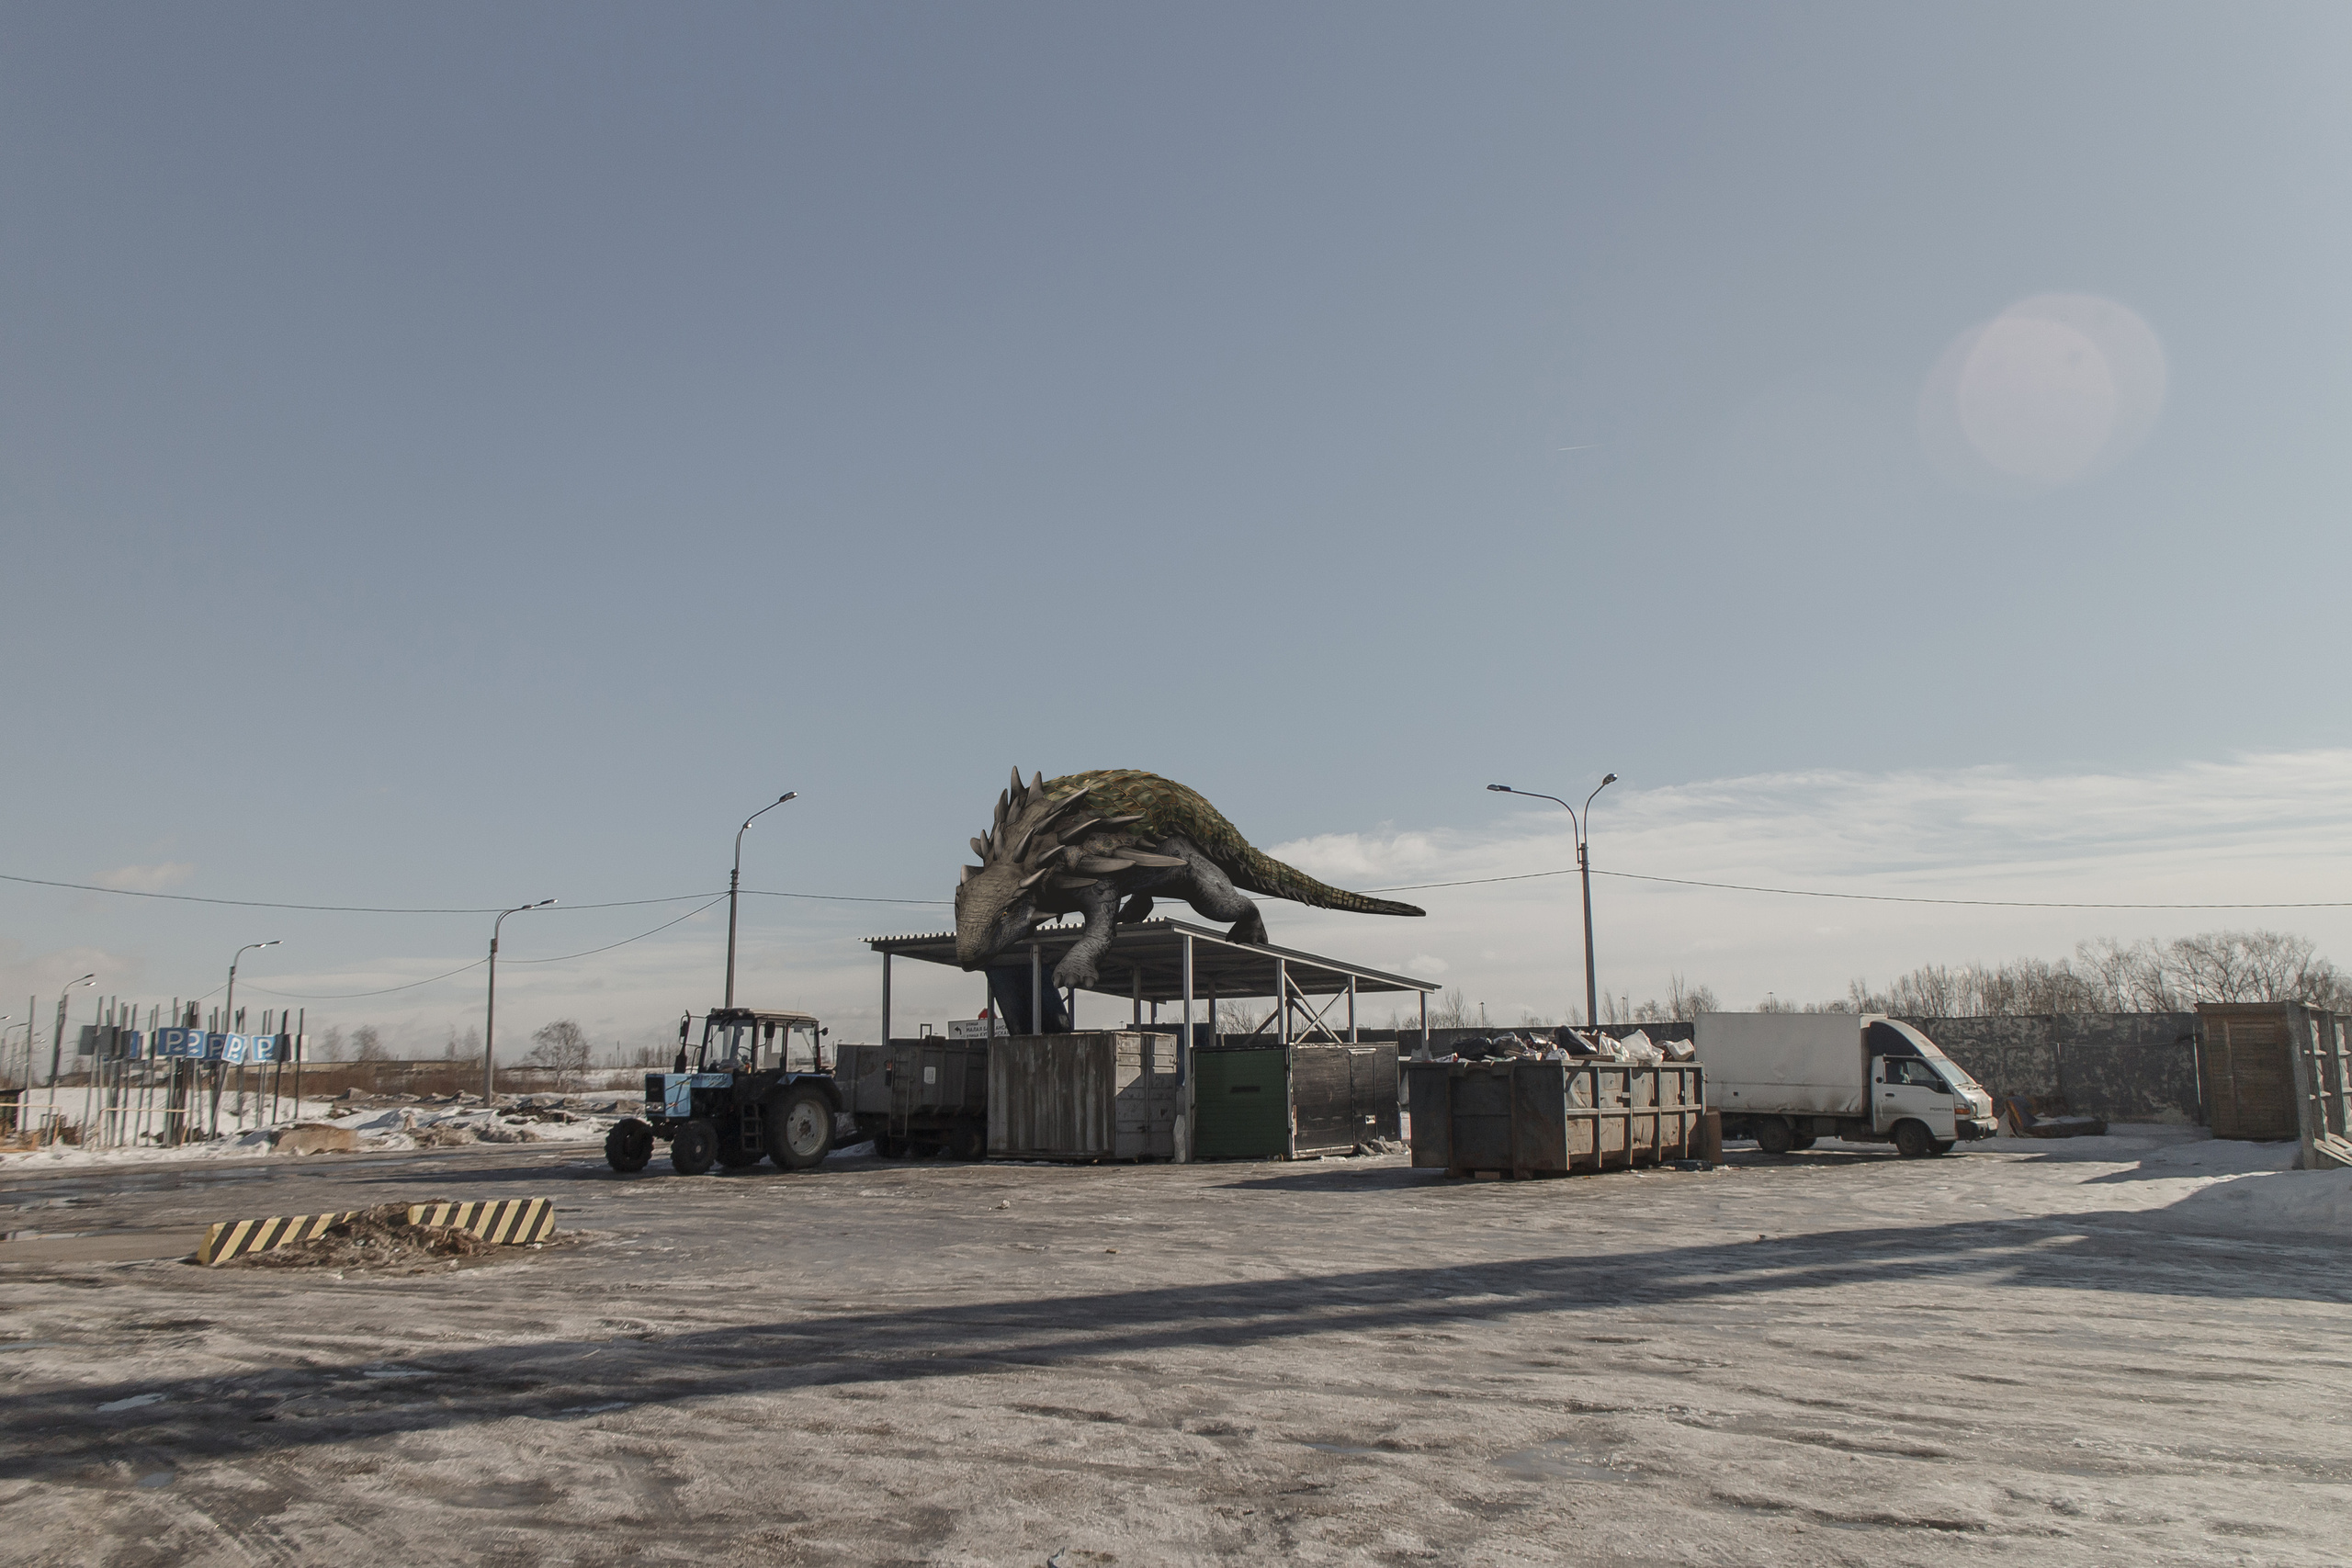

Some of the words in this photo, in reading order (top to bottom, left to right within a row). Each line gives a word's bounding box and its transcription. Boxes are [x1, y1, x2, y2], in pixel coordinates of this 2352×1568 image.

[165, 1031, 184, 1053] P
[209, 1037, 224, 1057] P
[227, 1037, 243, 1058] P
[257, 1039, 273, 1058] P
